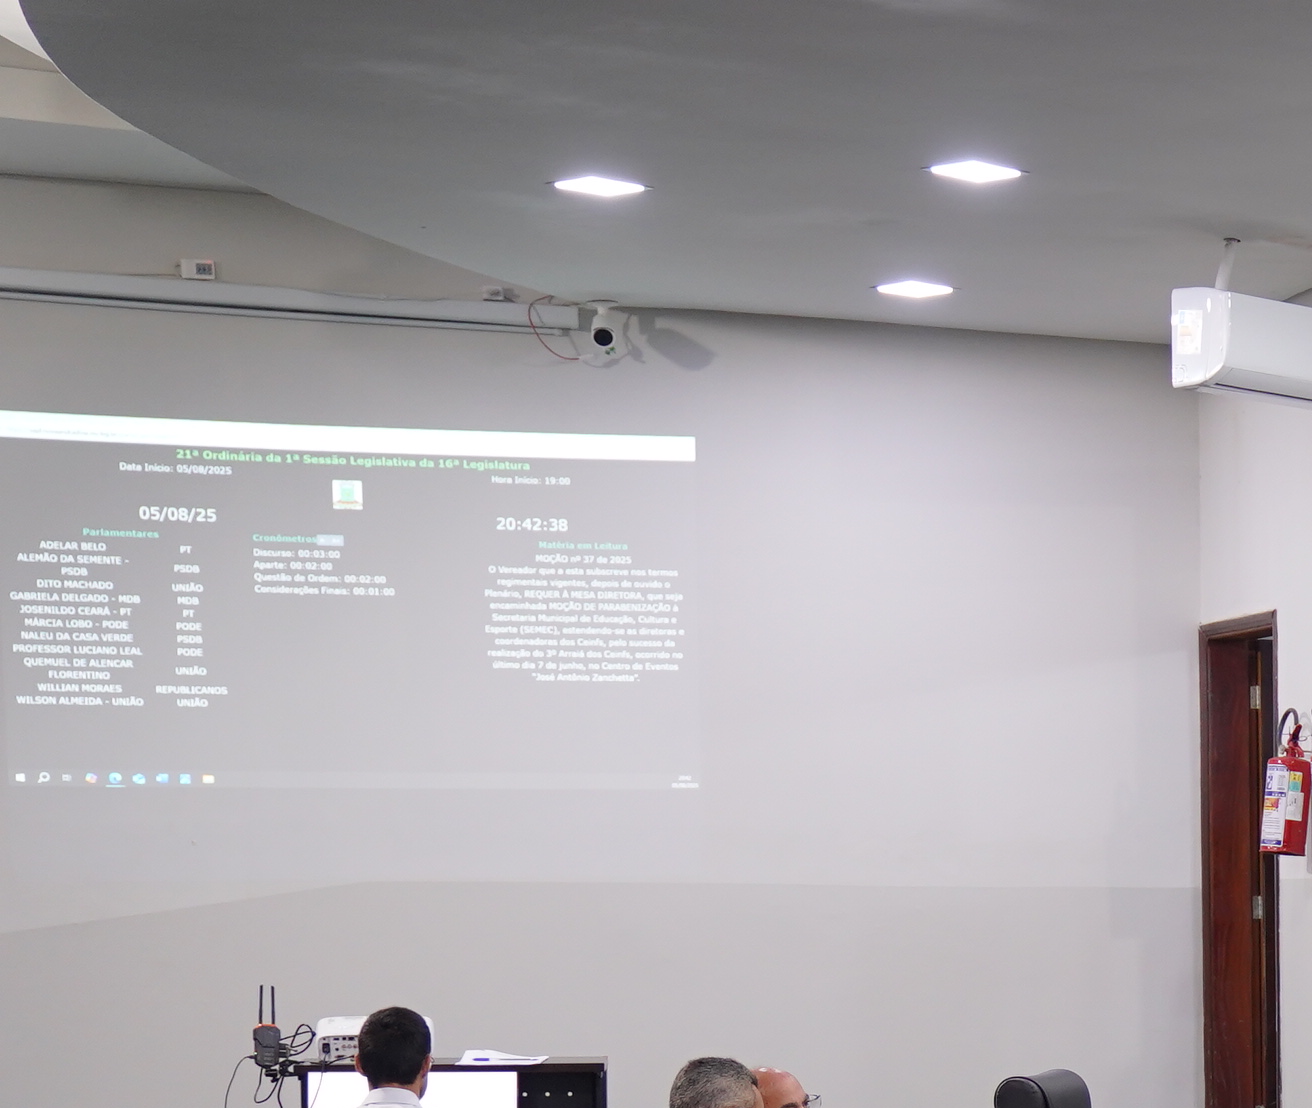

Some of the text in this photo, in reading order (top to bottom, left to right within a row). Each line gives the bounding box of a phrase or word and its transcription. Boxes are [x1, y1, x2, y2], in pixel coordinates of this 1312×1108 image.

[176, 449, 530, 471] 21ª Ordinária da 1ª Sessão Legislativa da 16ª Legislatura
